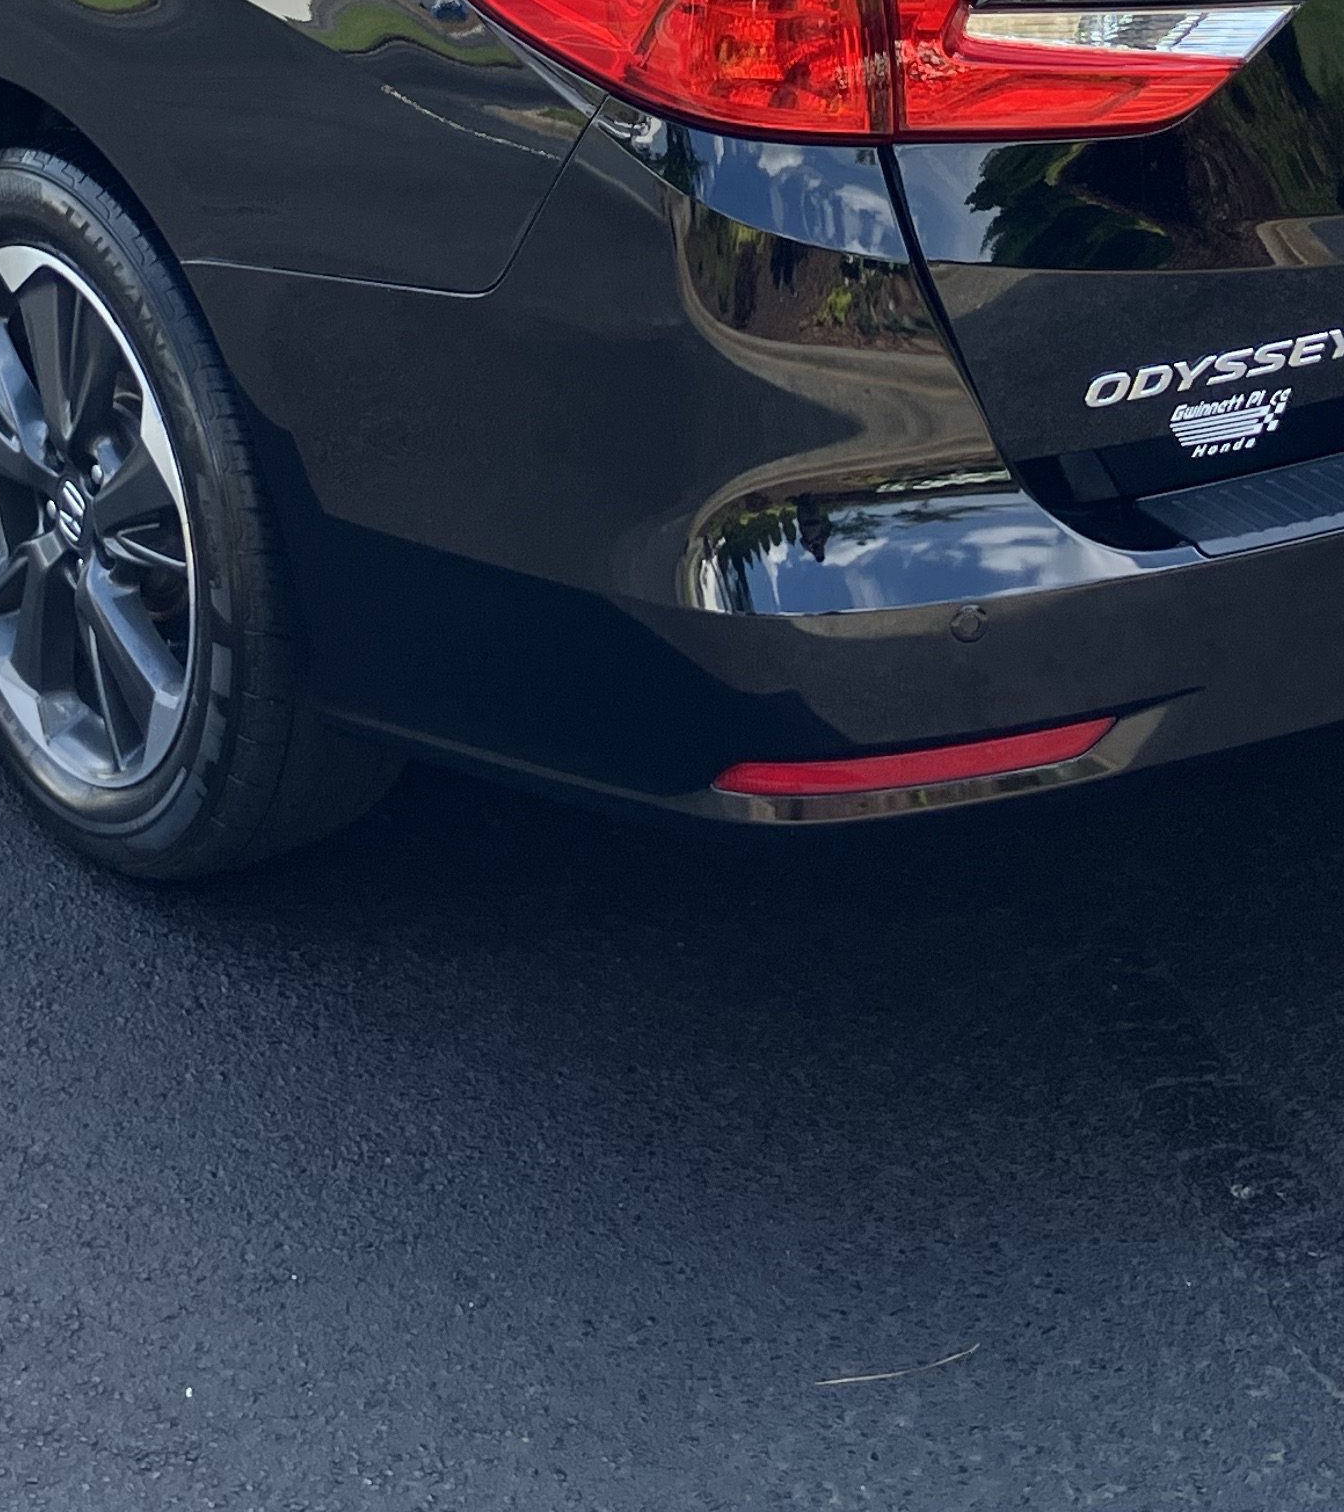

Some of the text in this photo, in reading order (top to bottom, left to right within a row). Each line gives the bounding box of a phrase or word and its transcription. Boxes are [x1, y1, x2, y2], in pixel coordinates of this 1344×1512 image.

[1170, 387, 1292, 422] Gwinnett Plce
[1191, 437, 1256, 458] Honda
